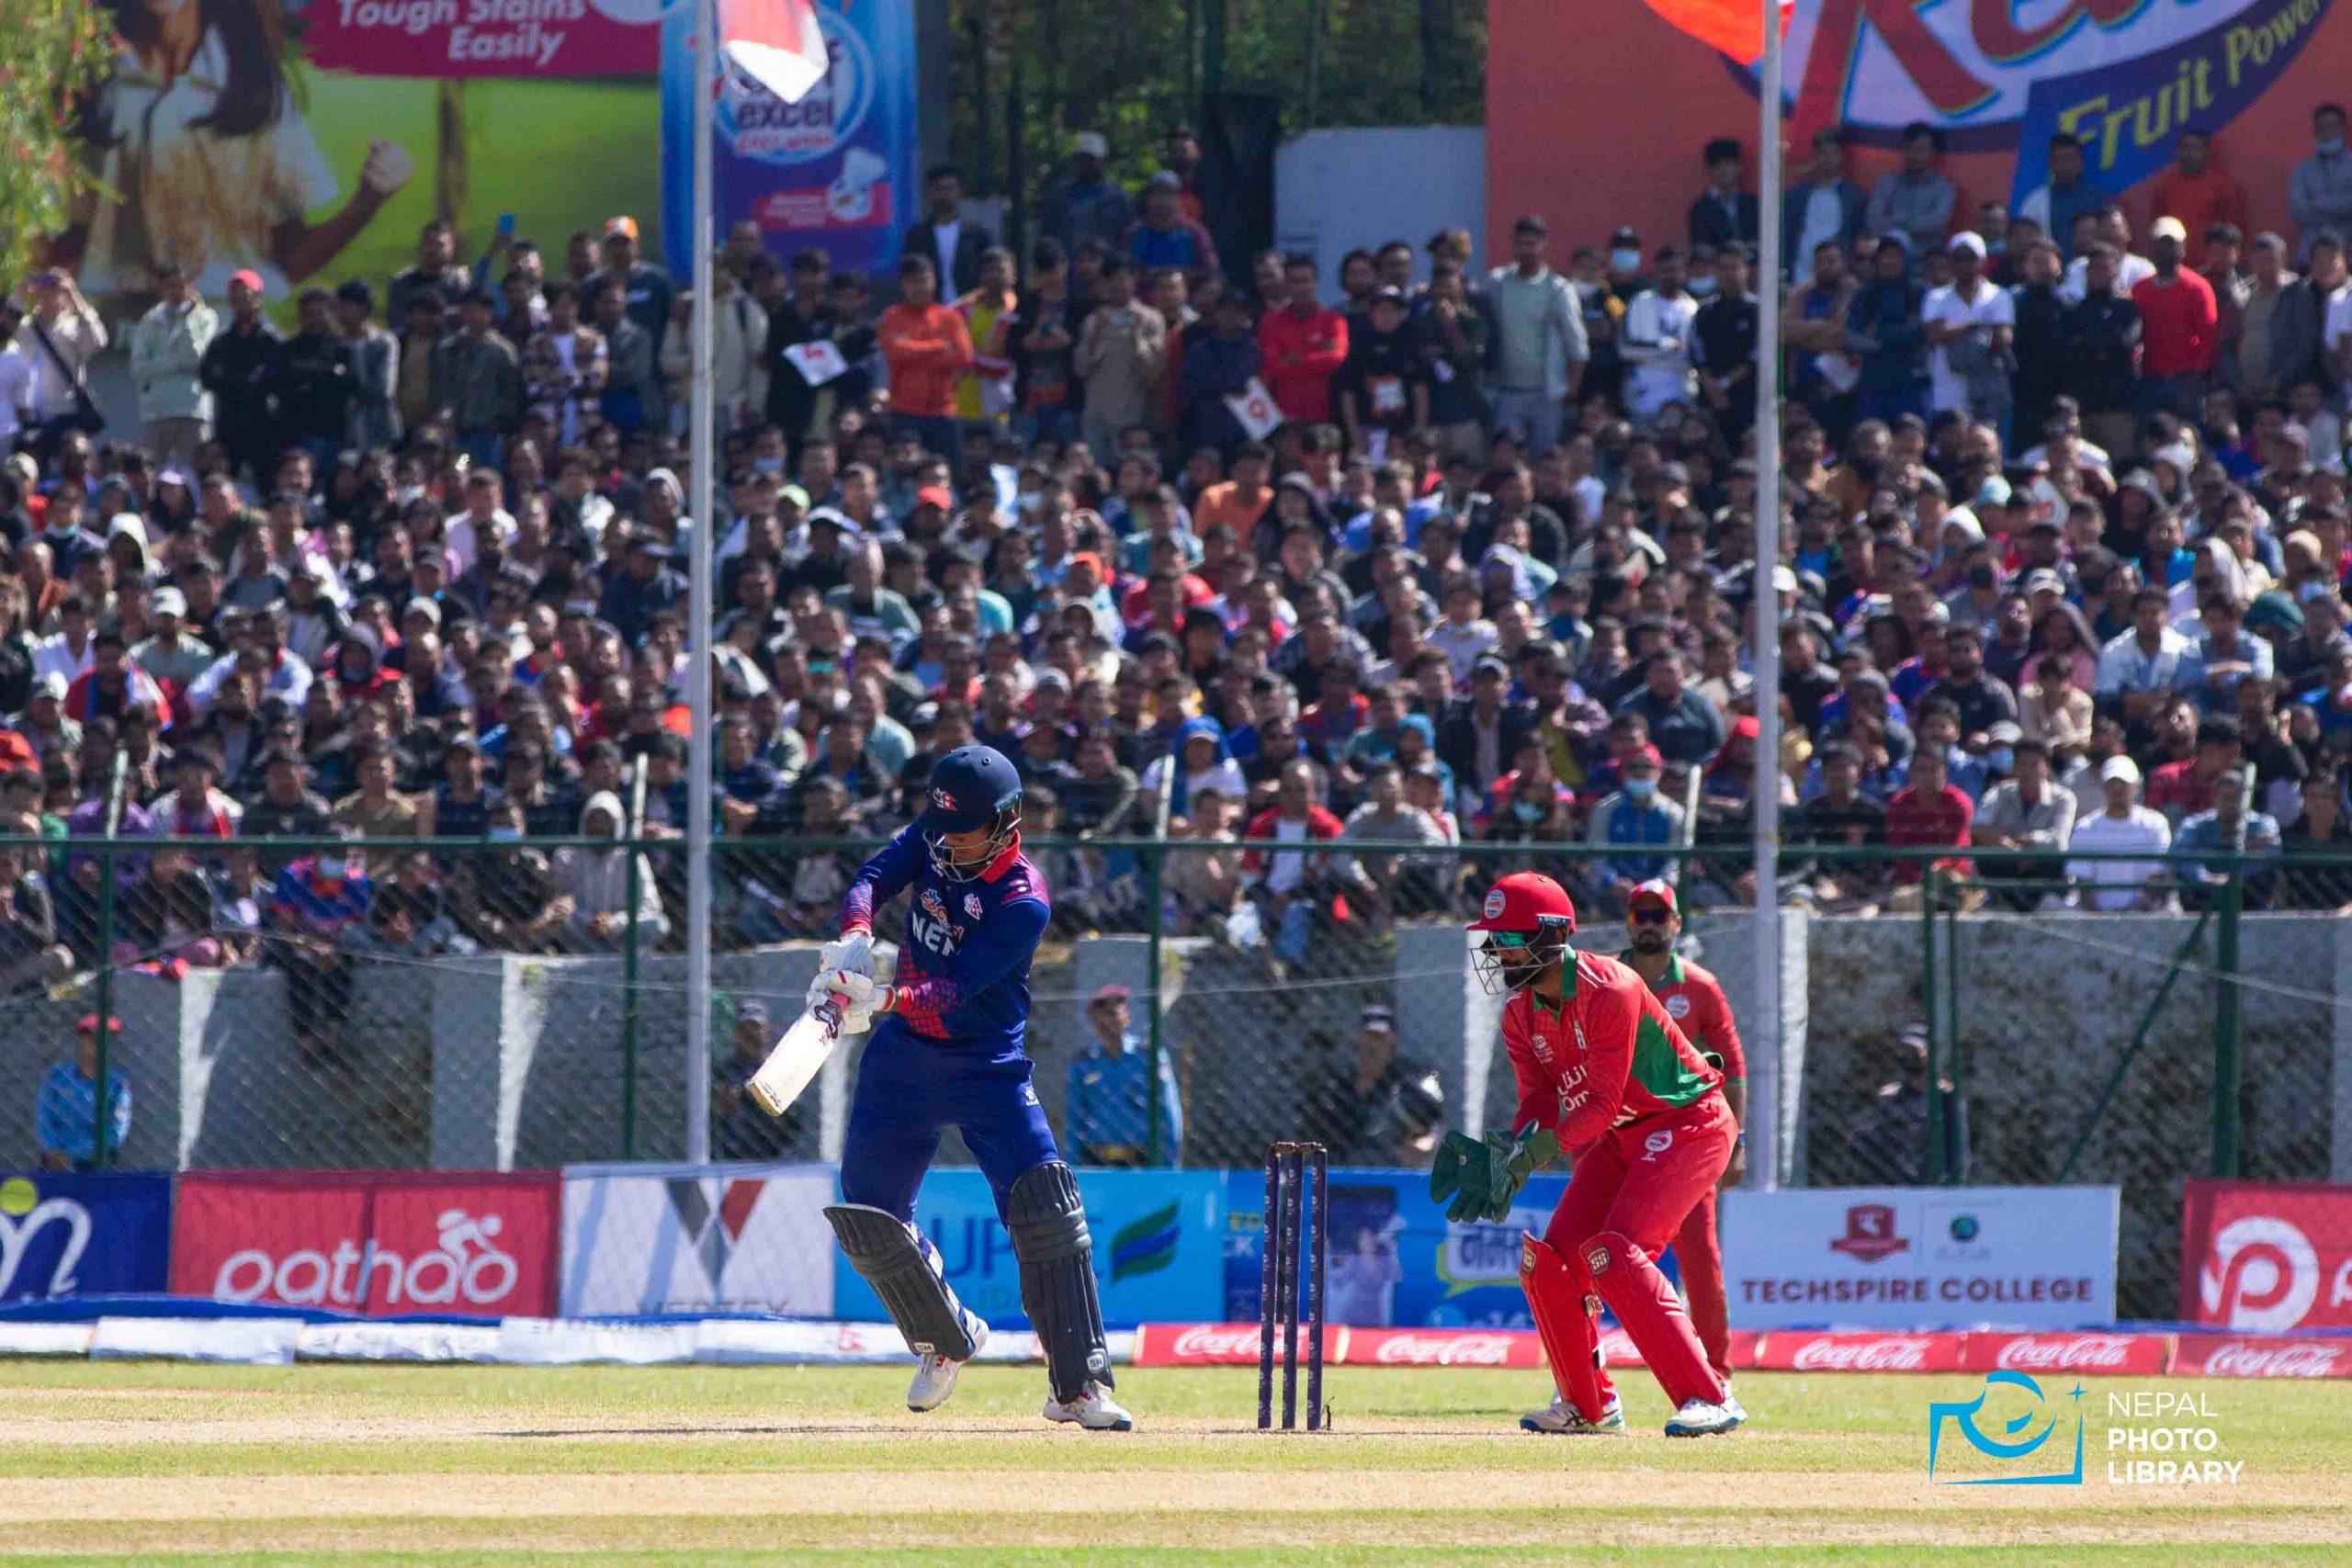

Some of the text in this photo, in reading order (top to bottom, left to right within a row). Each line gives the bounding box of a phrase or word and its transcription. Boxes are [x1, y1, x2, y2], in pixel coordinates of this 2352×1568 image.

[338, 0, 456, 33] Tough
[447, 25, 567, 67] Easily
[737, 97, 834, 130] excel
[2058, 61, 2215, 171] Fruit
[1742, 1278, 2094, 1303] TECHSPIRE COLLEGE
